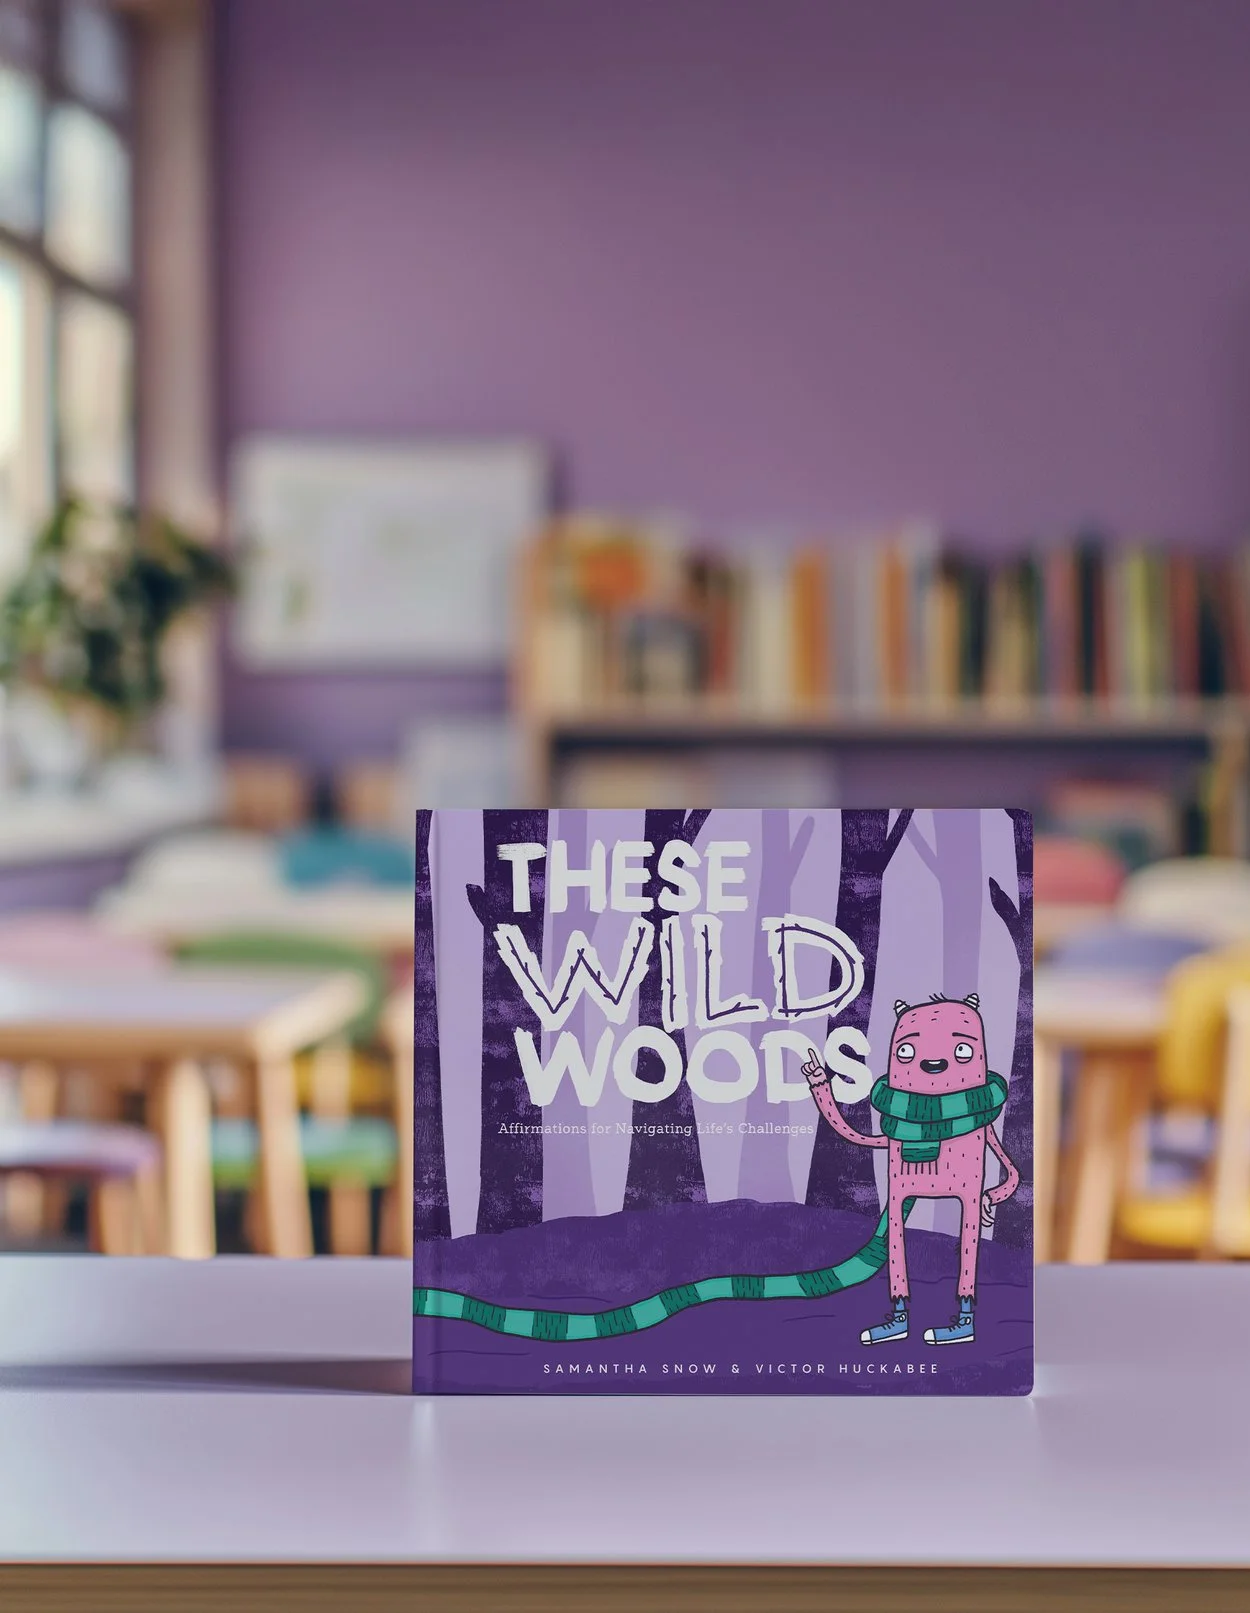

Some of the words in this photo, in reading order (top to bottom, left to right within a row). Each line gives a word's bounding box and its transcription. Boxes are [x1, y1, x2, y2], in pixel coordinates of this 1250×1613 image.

[496, 839, 752, 914] THESE
[493, 913, 866, 1032] WILD
[514, 1025, 874, 1107] WOODS
[497, 1122, 587, 1134] Affirmations
[591, 1122, 612, 1134] for
[615, 1122, 693, 1137] Navigating
[737, 1122, 814, 1137] Challenges
[543, 1363, 648, 1374] SAMANTHA
[662, 1363, 716, 1374] SNOW
[731, 1363, 740, 1374] &
[755, 1363, 826, 1374] VICTOR
[839, 1363, 938, 1374] HUCKABEE
